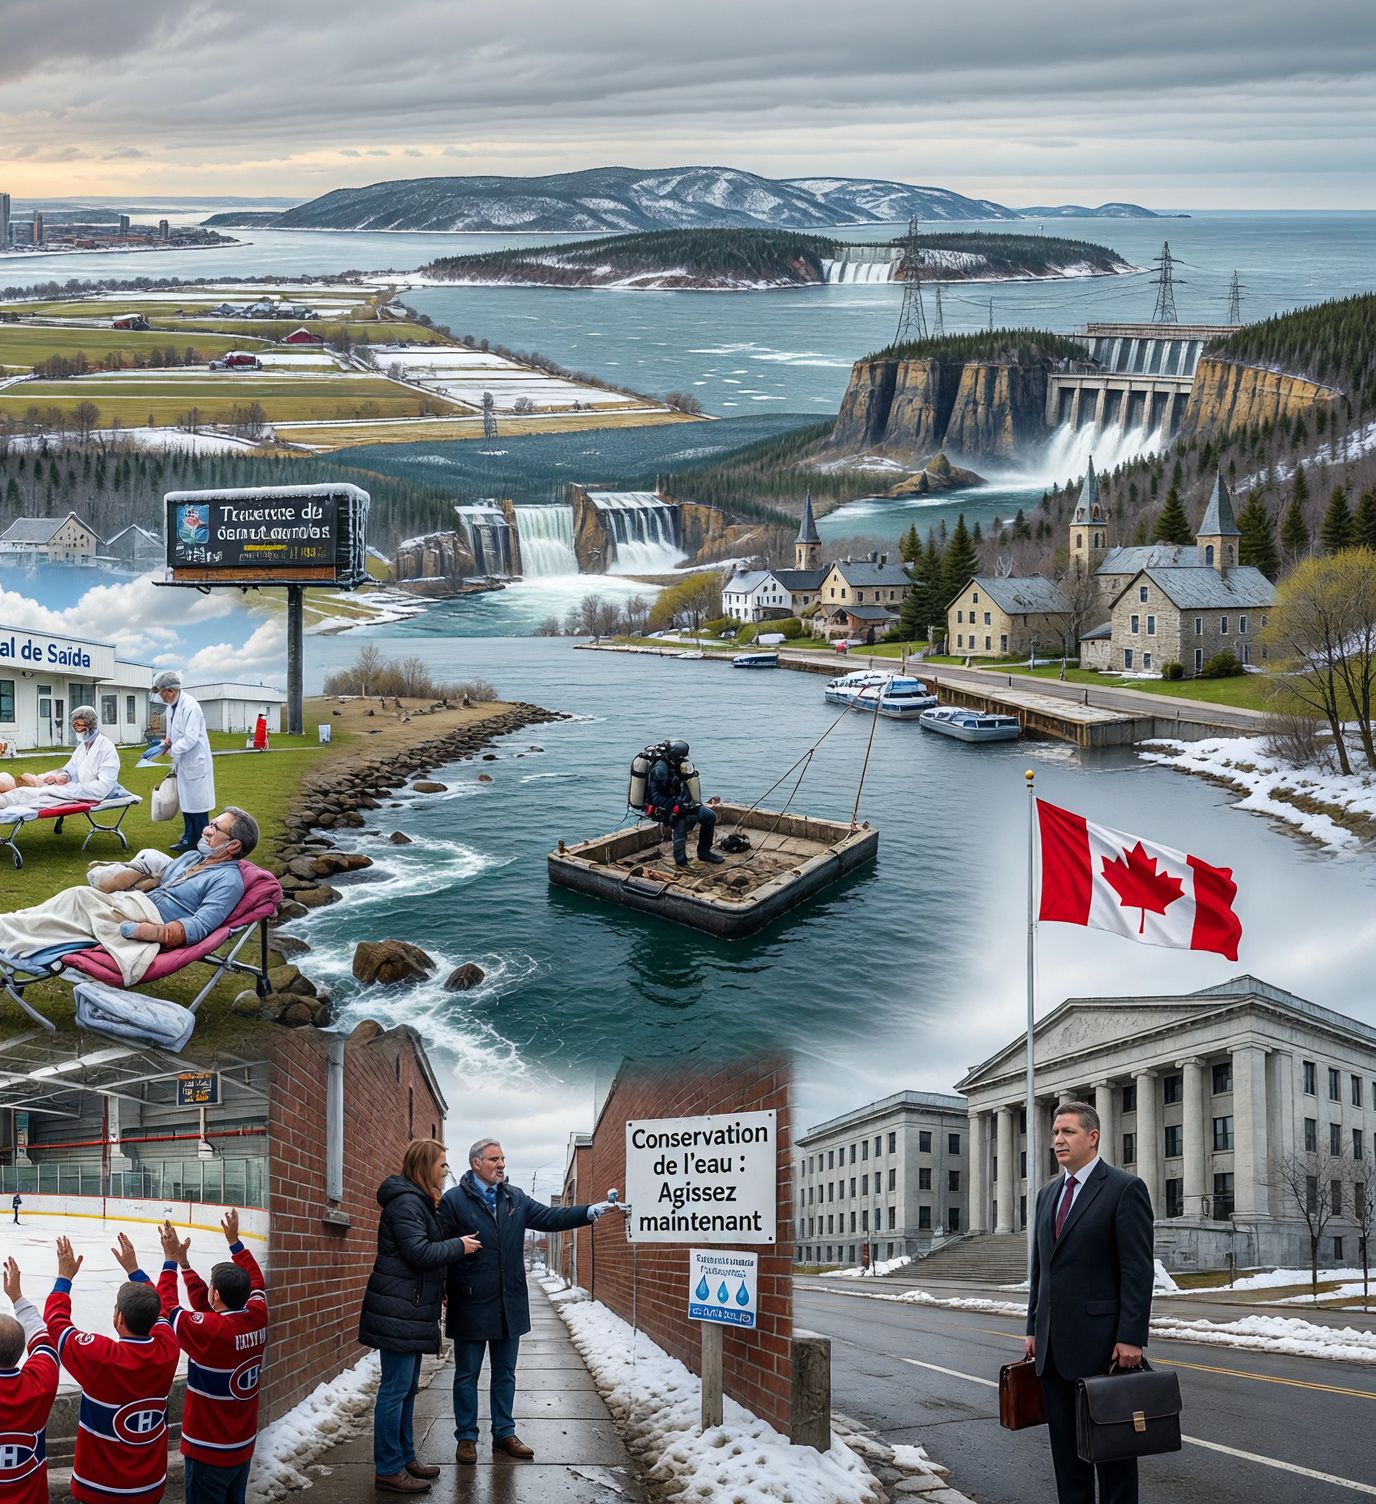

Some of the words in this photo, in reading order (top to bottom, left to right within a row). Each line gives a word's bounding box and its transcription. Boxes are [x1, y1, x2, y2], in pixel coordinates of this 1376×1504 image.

[21, 639, 43, 661] de
[47, 643, 91, 668] Saïda
[631, 1121, 768, 1149] Conservation
[653, 1154, 678, 1175] de
[657, 1181, 737, 1209] Agissez
[639, 1209, 762, 1232] maintenant
